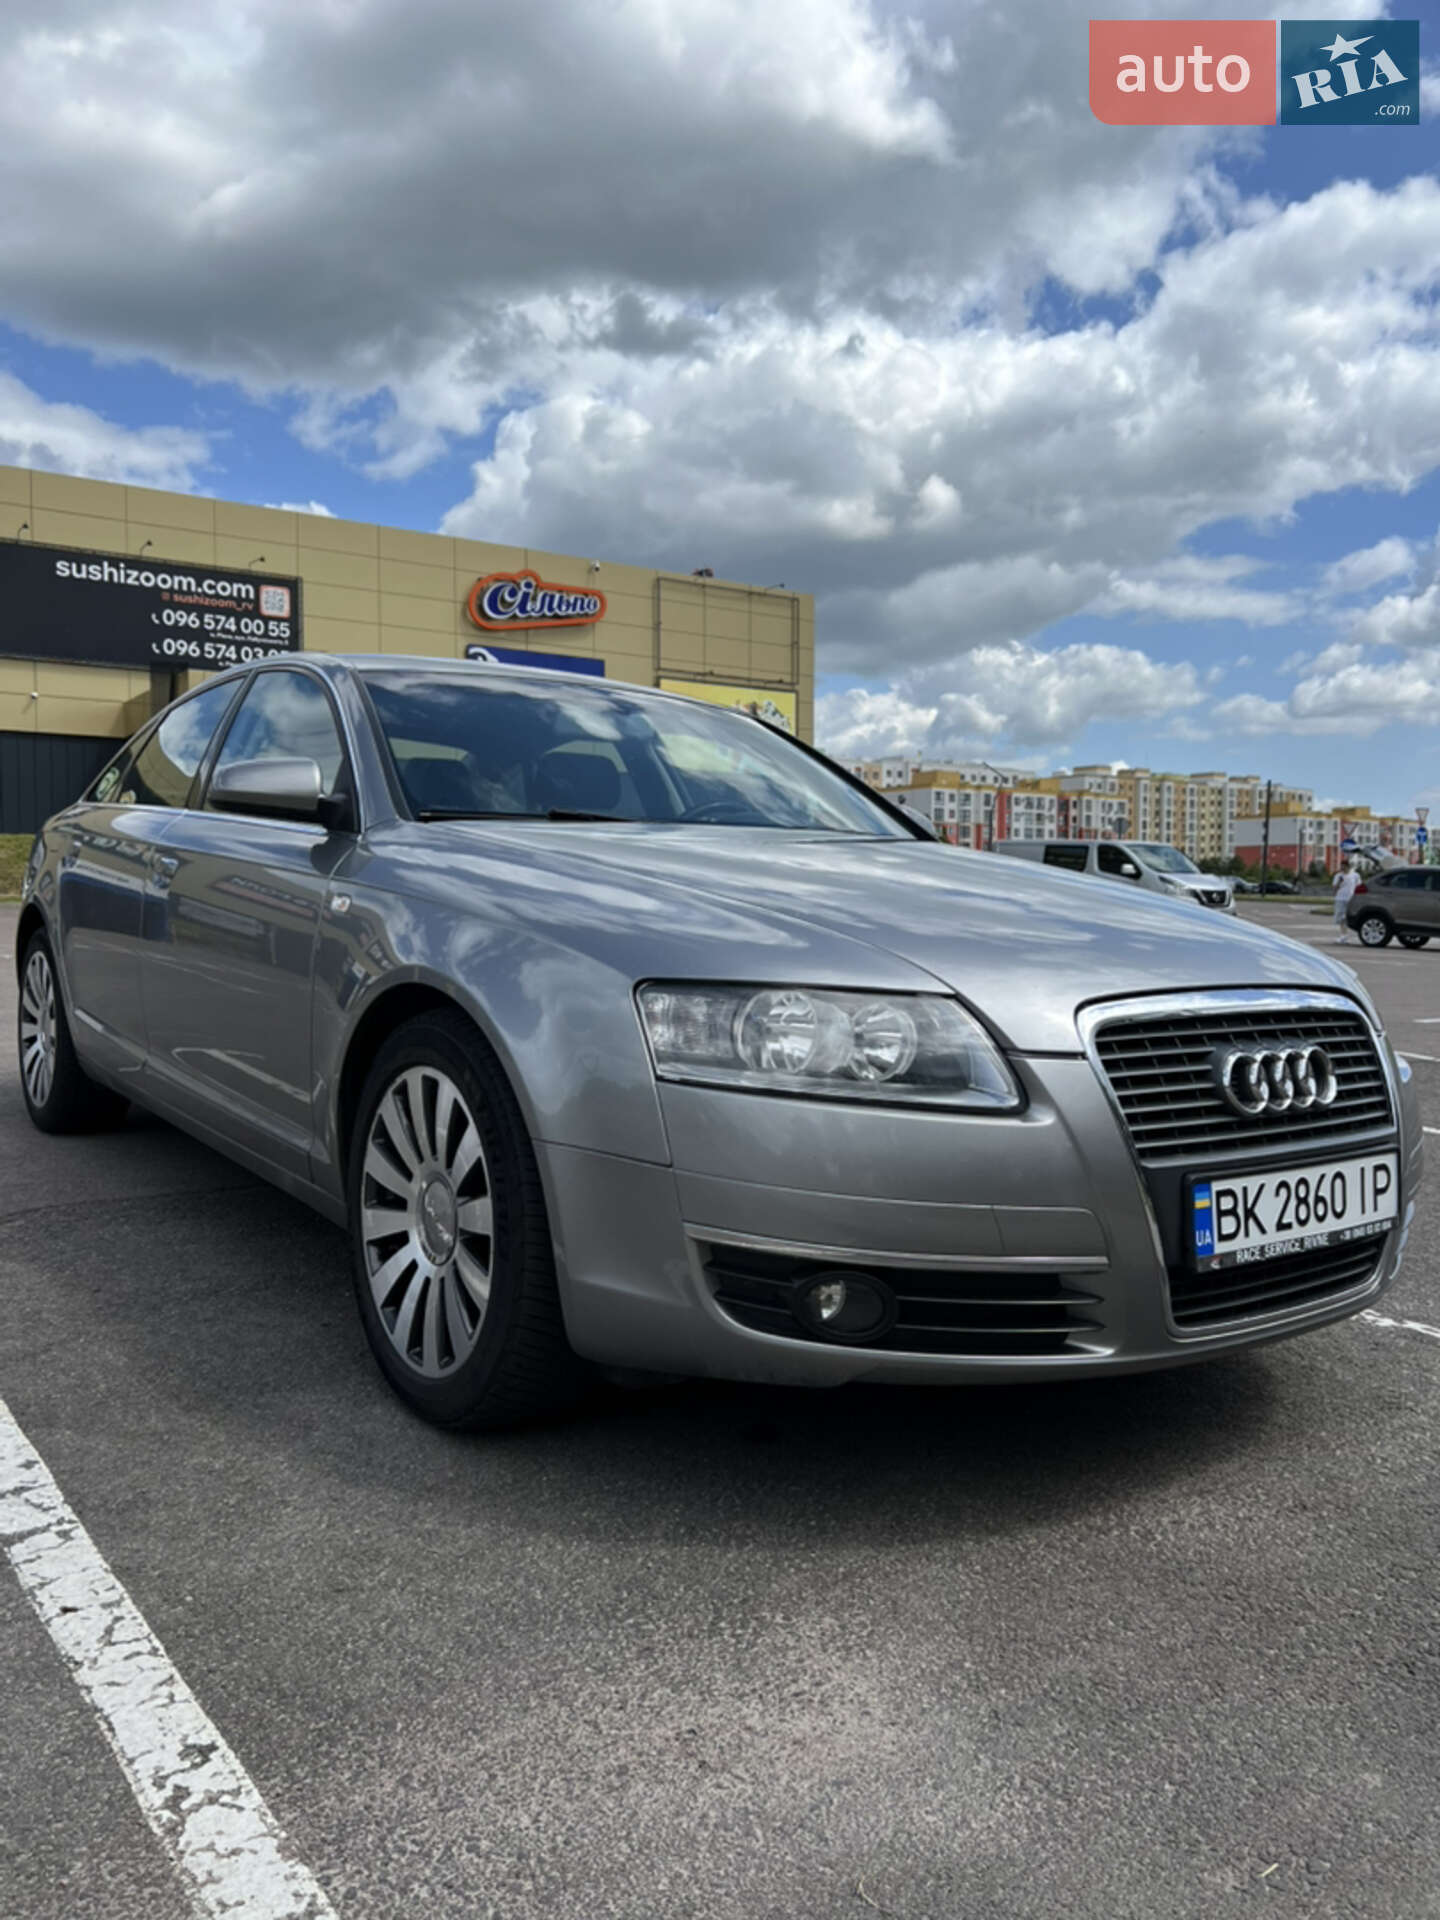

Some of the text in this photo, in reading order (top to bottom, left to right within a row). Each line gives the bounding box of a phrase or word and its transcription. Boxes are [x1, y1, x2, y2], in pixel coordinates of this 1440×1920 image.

[55, 559, 255, 600] sushizoom.com
[482, 579, 601, 620] Сільпо
[162, 608, 291, 638] 096 574 00 55
[162, 638, 201, 658] 096
[203, 642, 237, 661] 574
[1215, 1163, 1392, 1243] BK 2860 IP
[1195, 1229, 1213, 1247] UA
